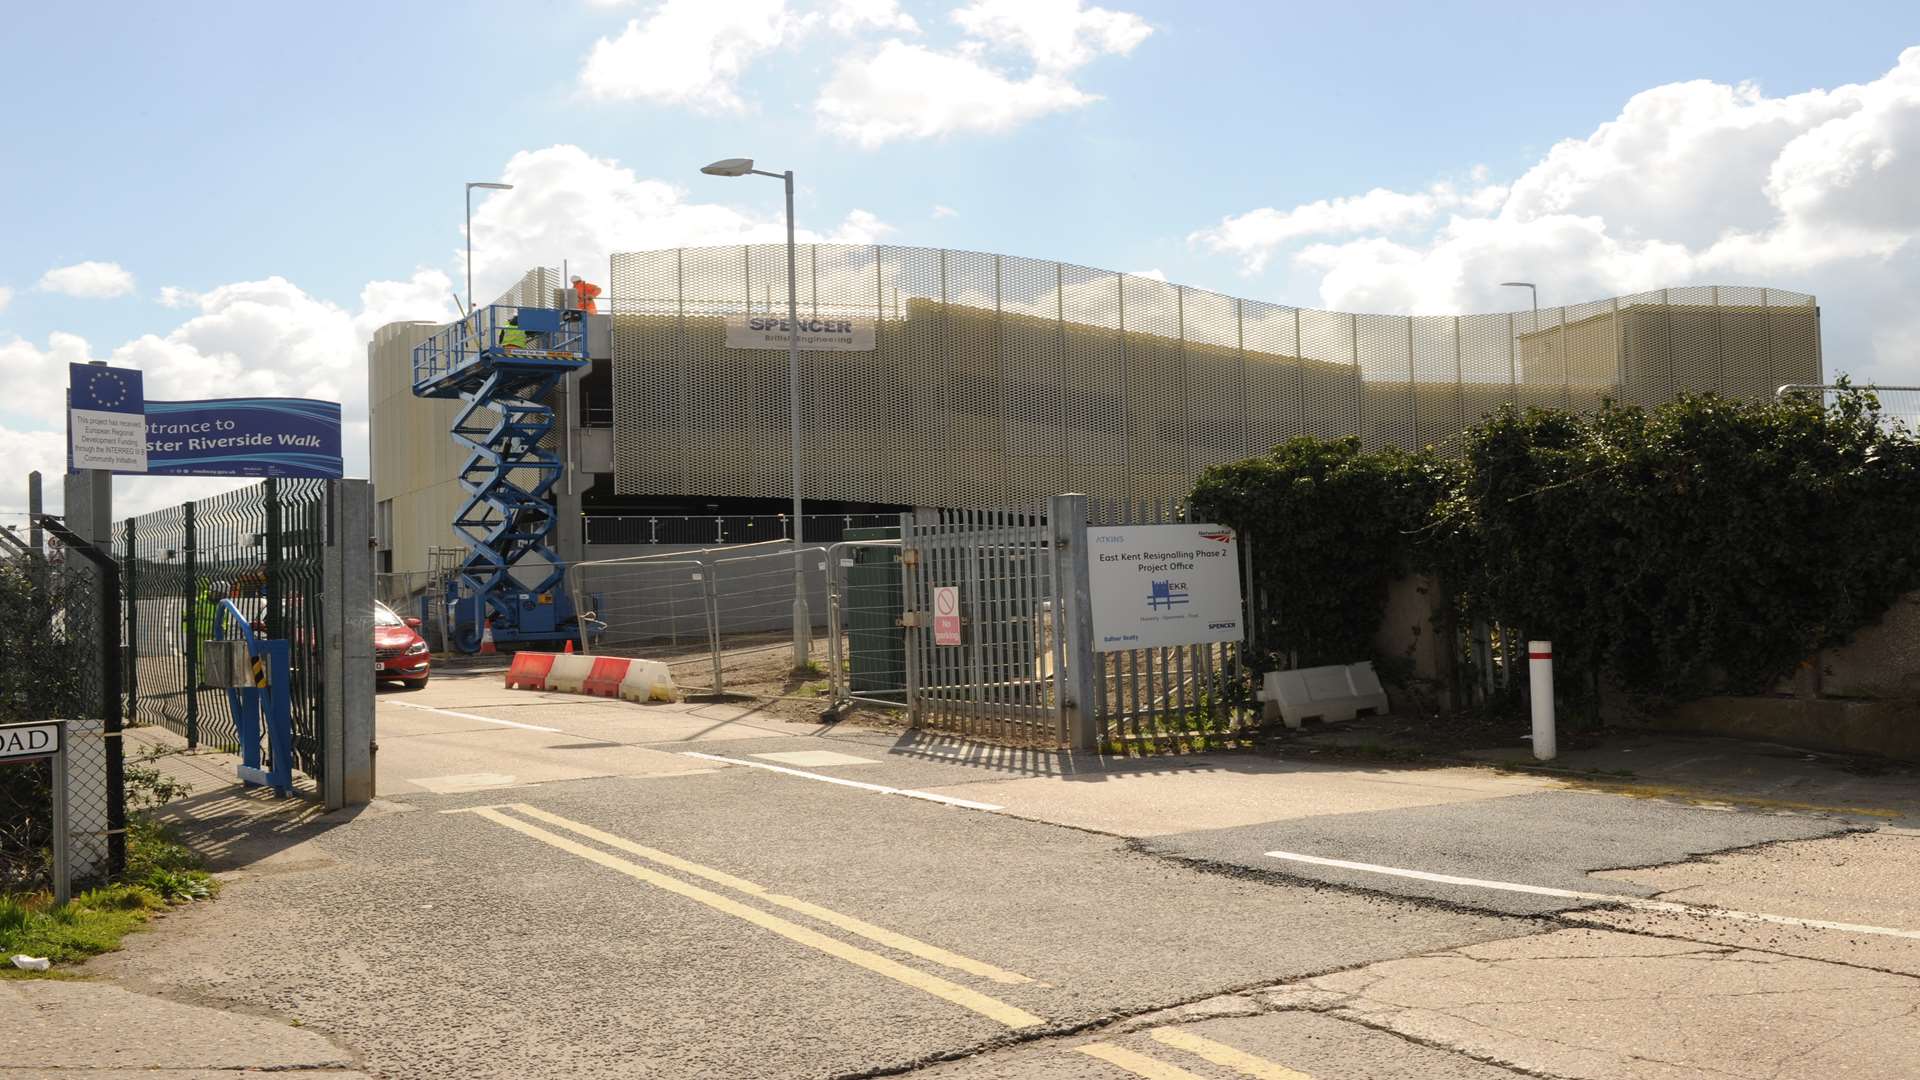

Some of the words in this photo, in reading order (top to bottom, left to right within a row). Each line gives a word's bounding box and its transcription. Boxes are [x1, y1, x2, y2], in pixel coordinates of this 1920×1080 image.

[750, 318, 852, 333] SPENCER
[77, 416, 89, 424] This
[90, 417, 107, 427] project
[145, 422, 210, 434] trance
[216, 419, 235, 430] to
[85, 427, 110, 436] European
[81, 436, 116, 445] Development
[117, 437, 138, 447] Funding
[189, 433, 272, 450] Riverside
[277, 433, 321, 448] Walk
[1099, 553, 1119, 561] East
[1121, 553, 1141, 561] Kent
[1143, 551, 1194, 561] Resignalling
[1196, 549, 1220, 558] Phase
[1138, 564, 1167, 573] Project
[1170, 562, 1194, 570] Office
